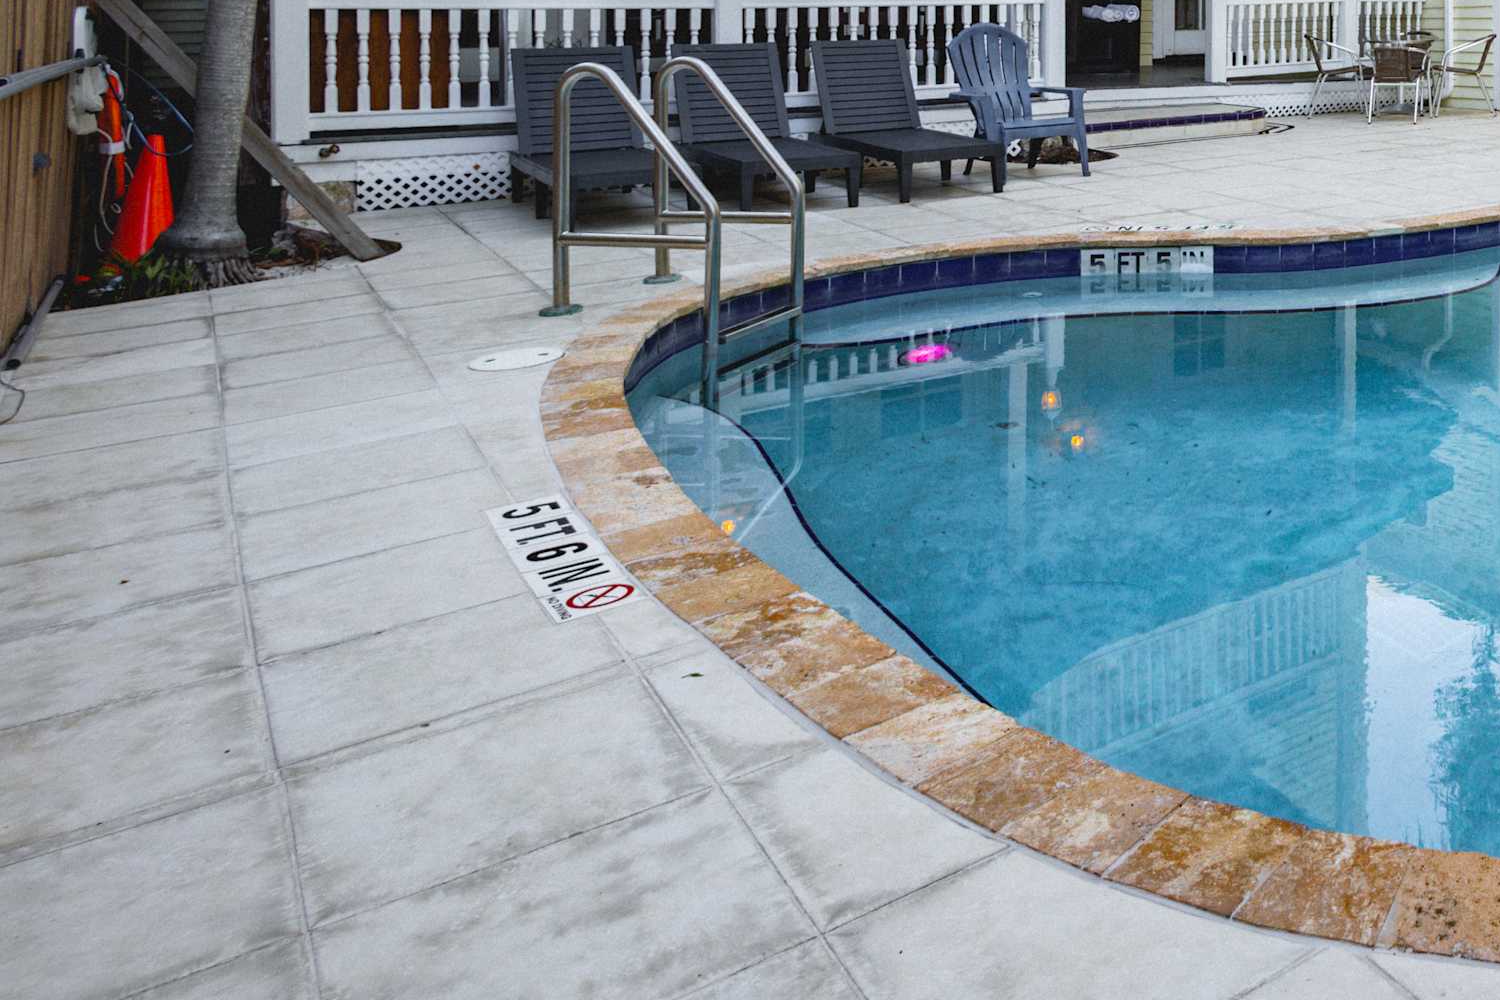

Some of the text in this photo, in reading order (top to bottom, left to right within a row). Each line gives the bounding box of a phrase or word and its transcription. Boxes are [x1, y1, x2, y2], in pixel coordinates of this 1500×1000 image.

[1090, 253, 1106, 273] 5
[1118, 251, 1145, 274] FT
[1156, 251, 1172, 273] 5
[502, 501, 561, 519] 5
[526, 541, 589, 562] 6
